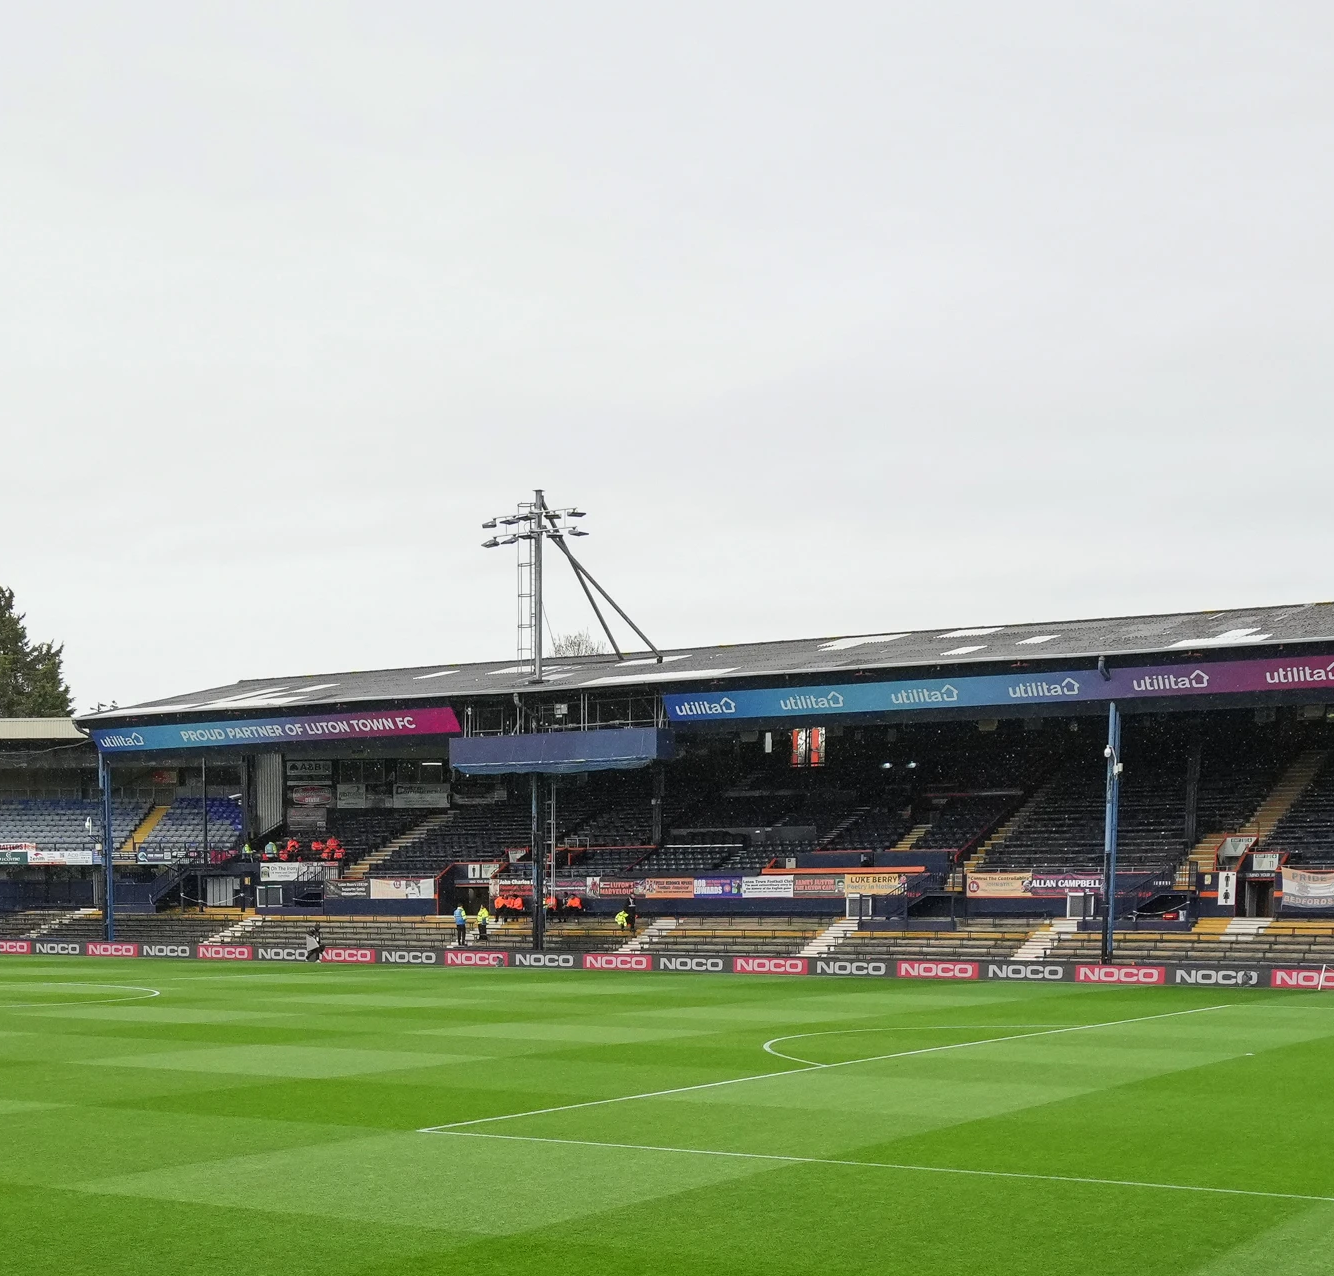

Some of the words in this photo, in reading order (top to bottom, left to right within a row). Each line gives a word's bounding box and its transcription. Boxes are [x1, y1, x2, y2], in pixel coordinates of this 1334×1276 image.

[1266, 666, 1327, 683] utilita
[1133, 674, 1191, 691] utilita
[891, 688, 943, 704] utilita
[1008, 681, 1063, 698] utilita
[675, 702, 722, 716] utilita
[780, 694, 828, 711] utilita
[101, 734, 135, 748] utilita
[180, 727, 225, 742] PROUD
[228, 724, 282, 739] PARTNER
[285, 723, 303, 736] OF
[306, 720, 349, 735] LUTON
[350, 718, 394, 732] TOWN
[396, 716, 416, 729] FC
[1292, 872, 1327, 882] PRIDE
[694, 886, 723, 894] EDWARDS
[1031, 880, 1057, 888] ALLAN
[1058, 880, 1102, 888] CAMPBELL
[36, 943, 79, 955] NOCO
[89, 944, 134, 956] NOCO
[143, 945, 190, 957] NOCO
[200, 946, 249, 959] NOCO
[258, 948, 308, 960] NOCO
[321, 949, 371, 961] NOCO
[382, 951, 436, 963] NOCO
[447, 952, 503, 965] NOCO
[516, 954, 574, 967] NOCO
[586, 956, 648, 969] NOCO
[660, 957, 723, 971] NOCO
[736, 958, 803, 972] NOCO
[818, 960, 886, 975] NOCO
[901, 962, 973, 978] NOCO
[988, 964, 1063, 980] NOCO
[1079, 966, 1159, 982] NOCO
